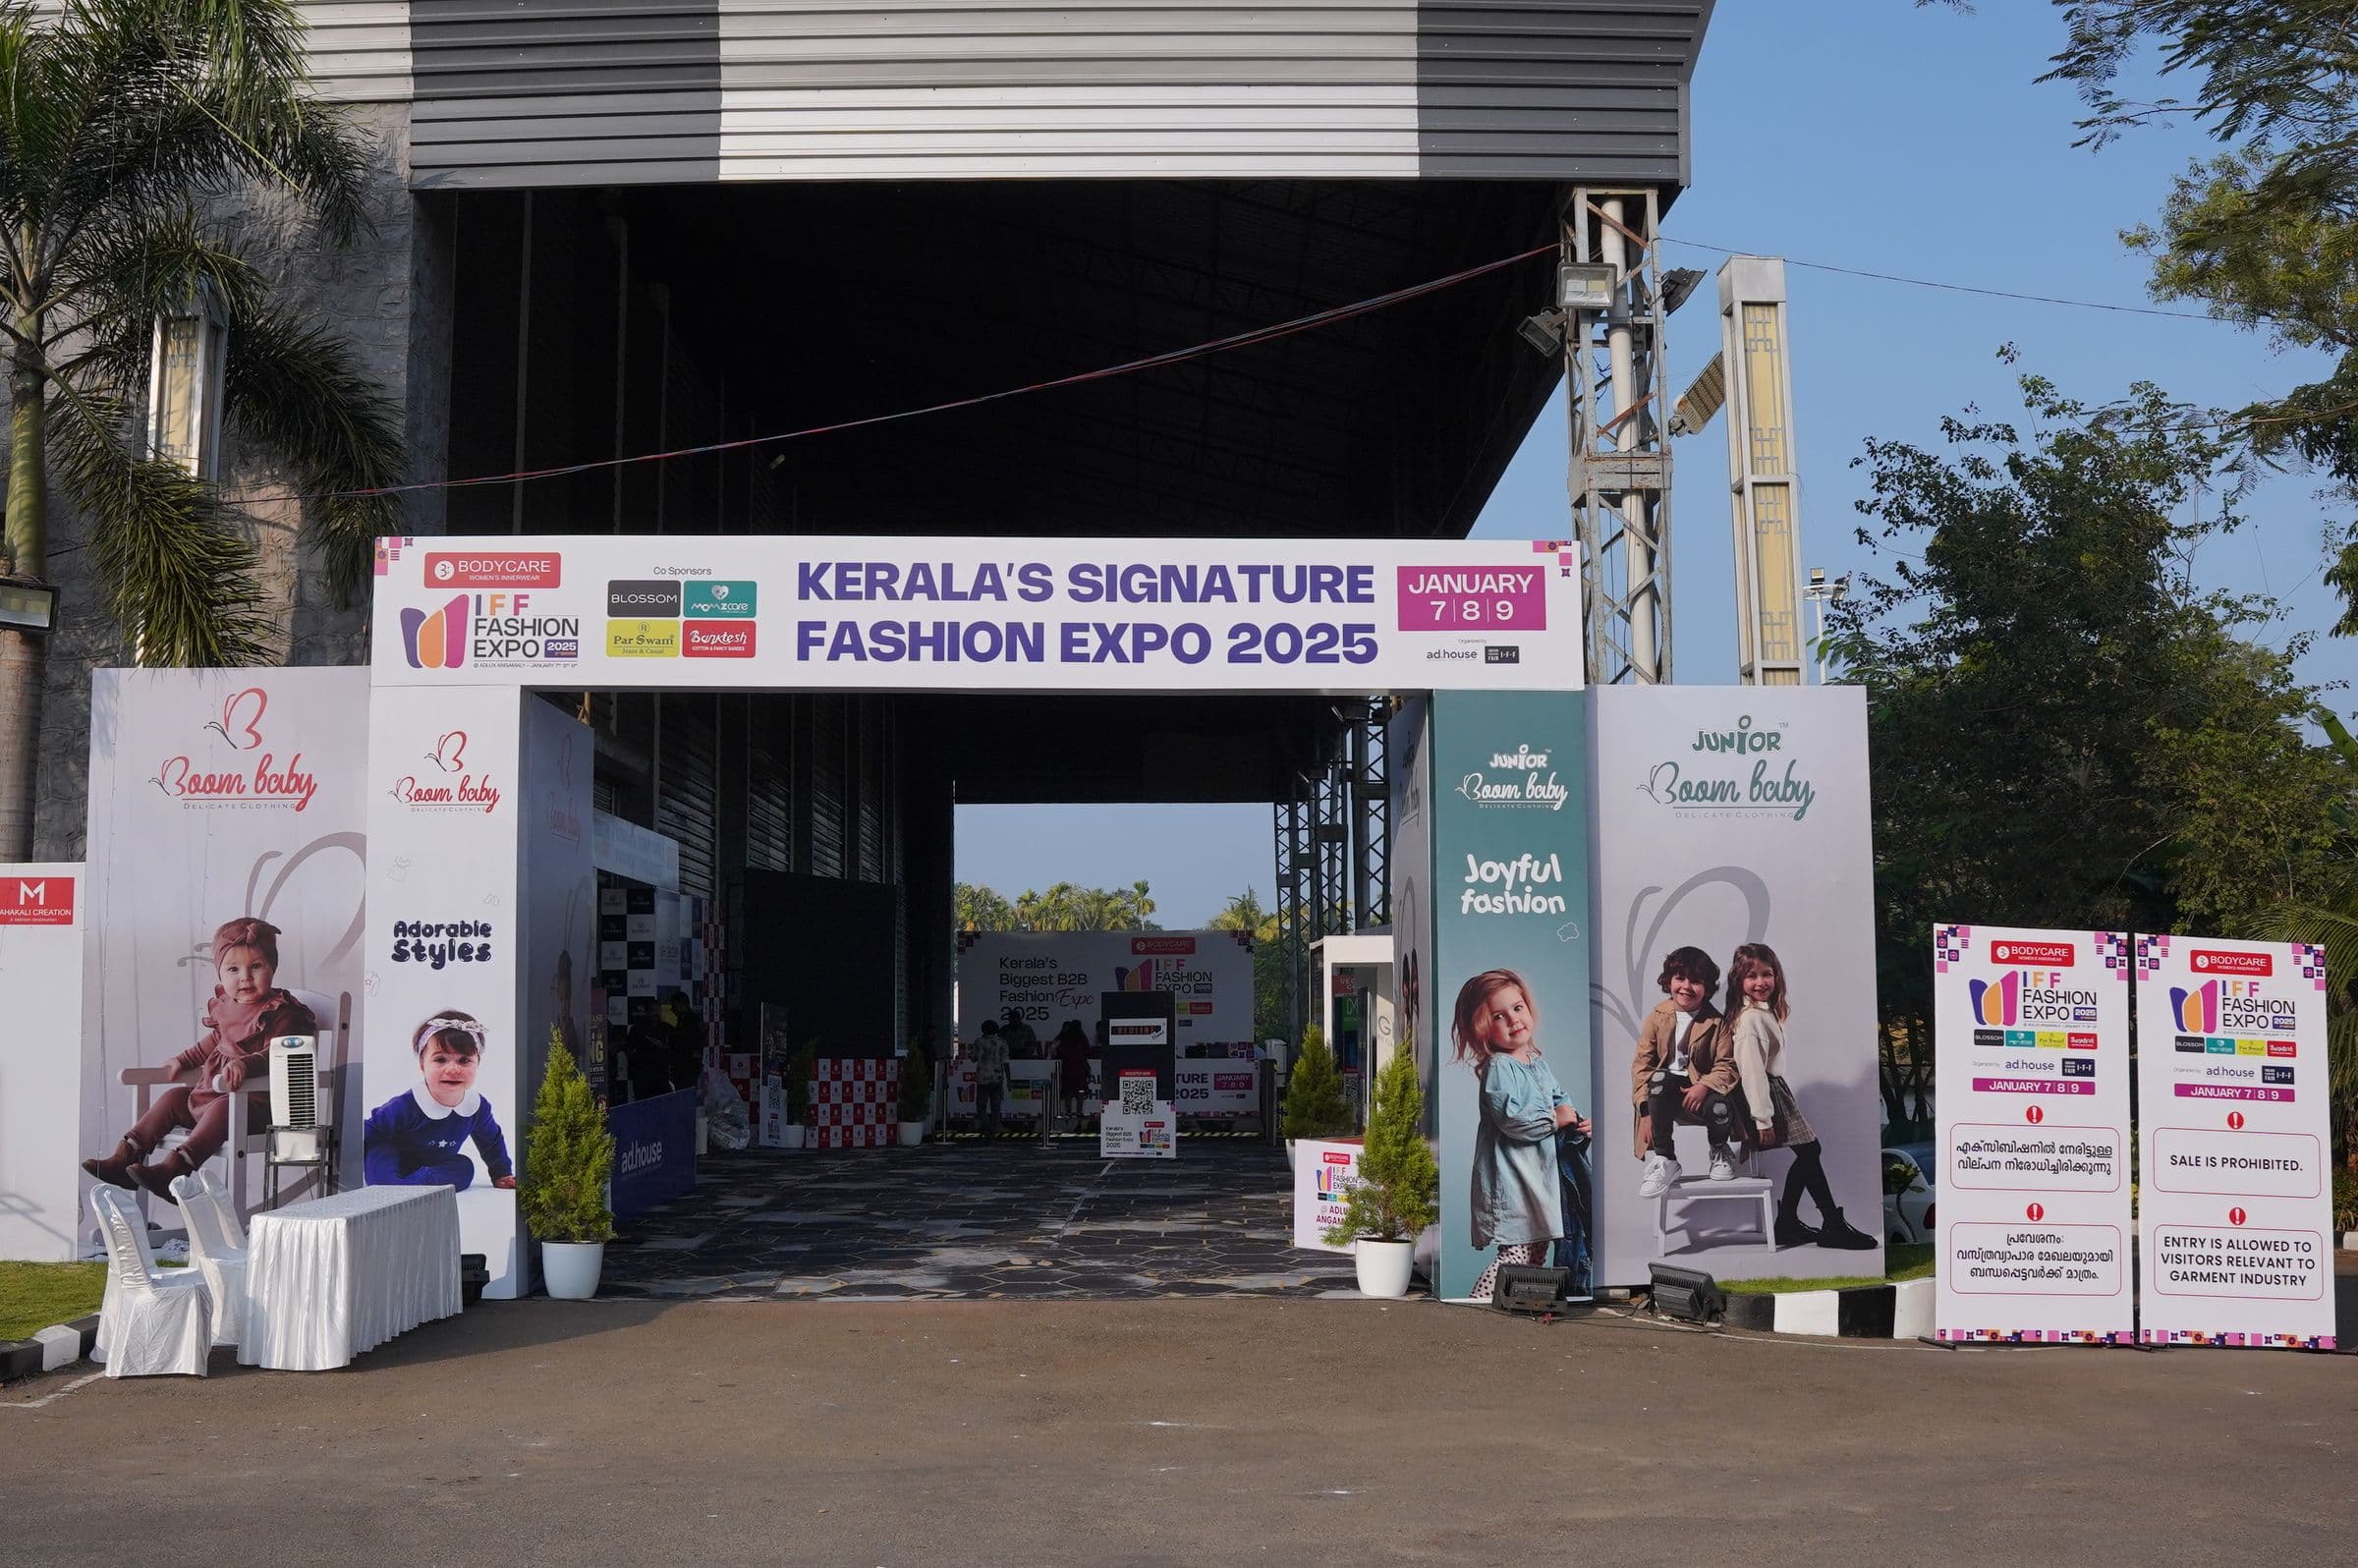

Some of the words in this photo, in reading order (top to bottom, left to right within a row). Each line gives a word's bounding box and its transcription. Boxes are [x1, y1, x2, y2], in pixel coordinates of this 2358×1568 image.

[458, 560, 551, 573] BODYCARE
[653, 566, 666, 575] Co
[668, 566, 712, 576] Sponsors
[798, 562, 1053, 602] KERALA'S
[1068, 563, 1376, 603] SIGNATURE
[1408, 574, 1534, 594] JANUARY
[611, 593, 677, 604] BLOSSOM
[474, 618, 579, 637] FASHION
[613, 635, 634, 644] Par
[797, 621, 1045, 663] FASHION
[1060, 621, 1211, 664] EXPO
[1227, 622, 1378, 664] 2025
[474, 640, 539, 658] EXPO
[546, 642, 577, 651] 2025
[1691, 714, 1781, 755] JUNIOR
[1488, 744, 1547, 770] JUNIOR
[149, 756, 247, 797] Boom
[254, 753, 317, 812] baby
[1637, 760, 1741, 805] Boom
[1749, 758, 1816, 821] baby
[388, 776, 453, 804] Boom
[458, 774, 500, 813] baby
[1455, 772, 1521, 801] Boom
[1525, 771, 1569, 812] baby
[1464, 853, 1562, 891] Joyful
[1461, 885, 1566, 915] fashion
[393, 920, 491, 938] Adorable
[391, 938, 491, 970] Styles
[2011, 946, 2068, 957] BODYCARE
[999, 957, 1057, 969] Kerala's
[2211, 956, 2267, 967] BODYCARE
[999, 974, 1053, 987] Biggest
[1057, 974, 1088, 984] B2B
[1155, 972, 1212, 982] FASHION
[999, 990, 1054, 1002] Fashion
[1054, 988, 1095, 1009] Expo
[2023, 989, 2097, 1005] FASHION
[1001, 1006, 1049, 1021] 2025
[2023, 1006, 2069, 1021] EXPO
[2222, 998, 2295, 1015] FASHION
[2222, 1014, 2269, 1029] EXPO
[2005, 1059, 2054, 1071] ad.house
[2206, 1067, 2255, 1078] ad.house
[1176, 1074, 1208, 1084] TURE
[1990, 1083, 2041, 1092] JANUARY
[2191, 1087, 2241, 1098] JANUARY
[2058, 1142, 2113, 1158] നേരിട്ടുള്ള
[2170, 1155, 2202, 1167] SALE
[2206, 1156, 2217, 1167] IS
[2221, 1157, 2303, 1171] PROHIBITED.
[1329, 1205, 1348, 1215] ADLU
[2163, 1236, 2207, 1250] ENTRY
[2211, 1238, 2222, 1250] IS
[2226, 1239, 2289, 1252] ALLOWED
[2294, 1242, 2312, 1253] TO
[1957, 1248, 2034, 1263] വസ്ത്രവ്യാപാര
[2038, 1250, 2113, 1264] മേഖലയുമായി
[2162, 1253, 2222, 1266] VISITORS
[2227, 1256, 2292, 1269] RELEVANT
[2298, 1259, 2315, 1270] TO
[2169, 1270, 2235, 1284] GARMENT
[2240, 1273, 2307, 1286] INDUSTRY
